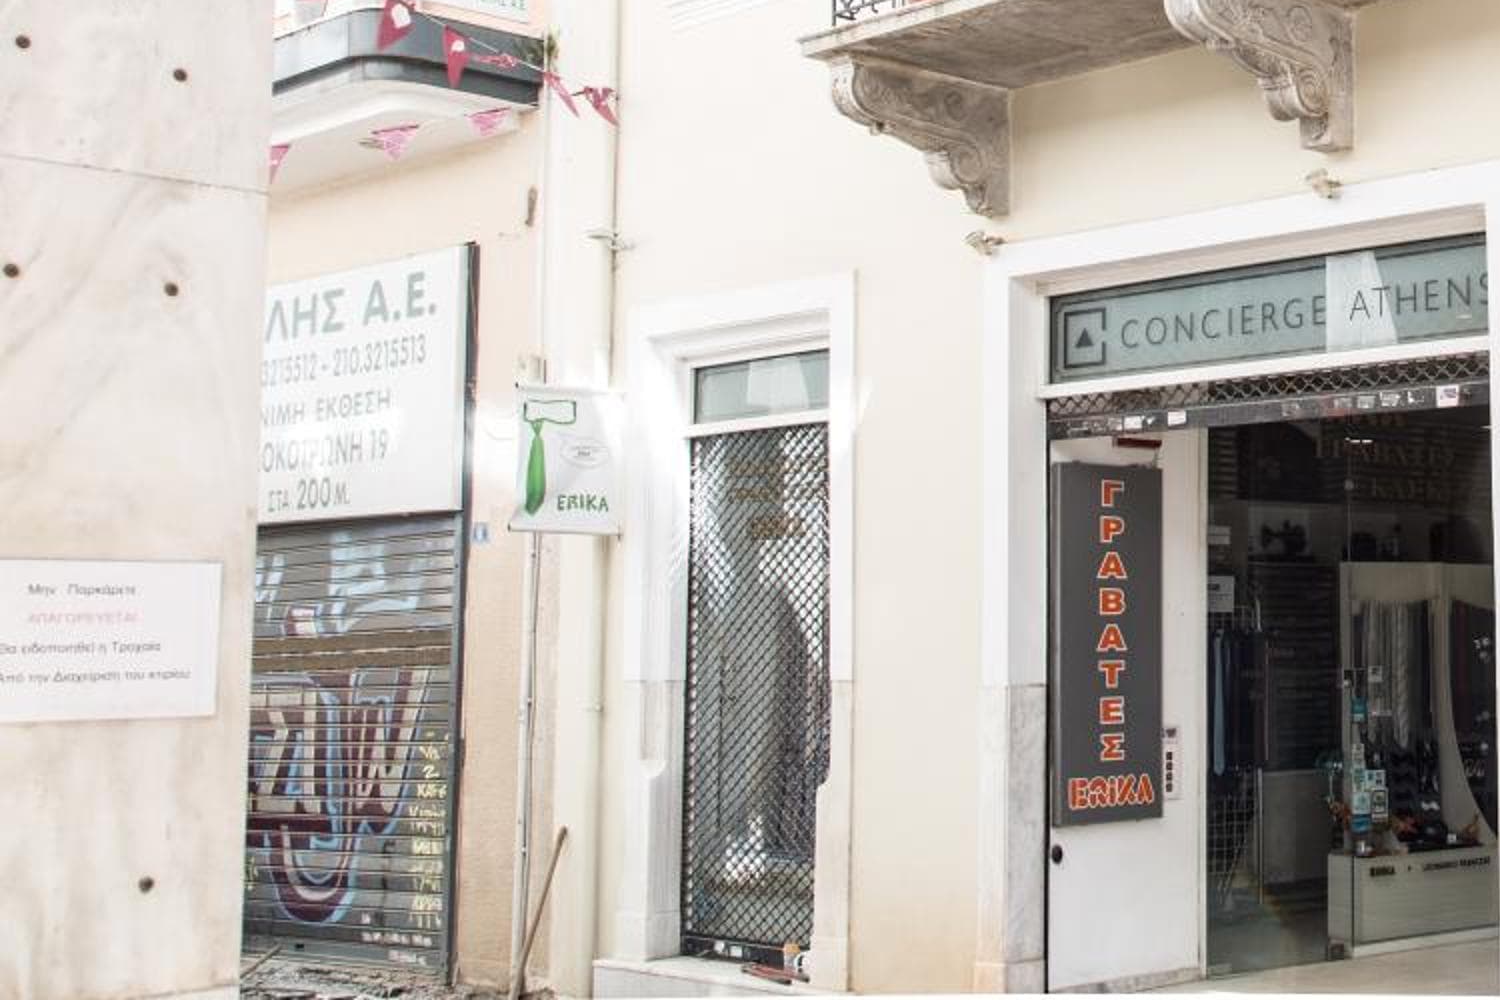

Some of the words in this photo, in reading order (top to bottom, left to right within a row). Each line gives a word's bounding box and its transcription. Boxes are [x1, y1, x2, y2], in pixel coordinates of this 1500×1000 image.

[266, 288, 345, 342] ΛΗΣ
[363, 271, 437, 326] Α.Ε.
[1121, 295, 1326, 349] CONCIERGE
[316, 387, 391, 421] ΕΚΘΕΣΗ
[370, 427, 388, 462] 19
[557, 494, 609, 513] ERIKA
[1098, 480, 1127, 760] ΓΡΑΒΑΤΕΣ
